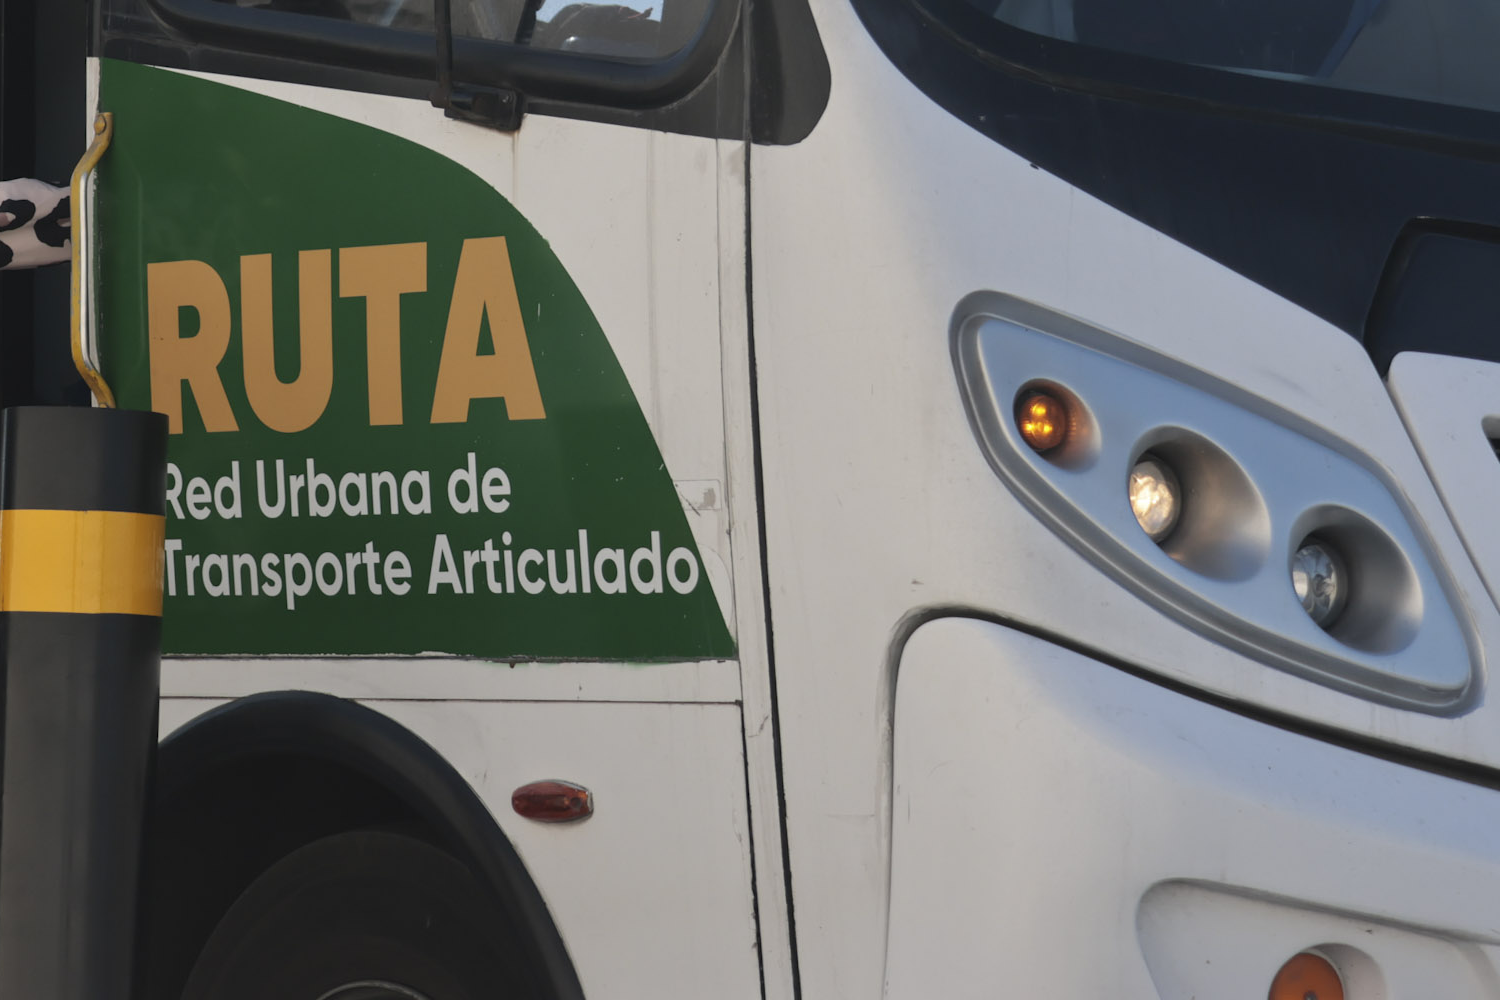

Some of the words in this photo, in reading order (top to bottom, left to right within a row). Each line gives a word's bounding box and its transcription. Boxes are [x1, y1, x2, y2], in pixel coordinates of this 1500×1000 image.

[147, 236, 546, 434] RUTA
[165, 460, 243, 521] Red
[255, 457, 432, 518] Urbana
[447, 451, 512, 514] de
[164, 538, 412, 611] Transporte
[427, 528, 700, 596] Articulado
